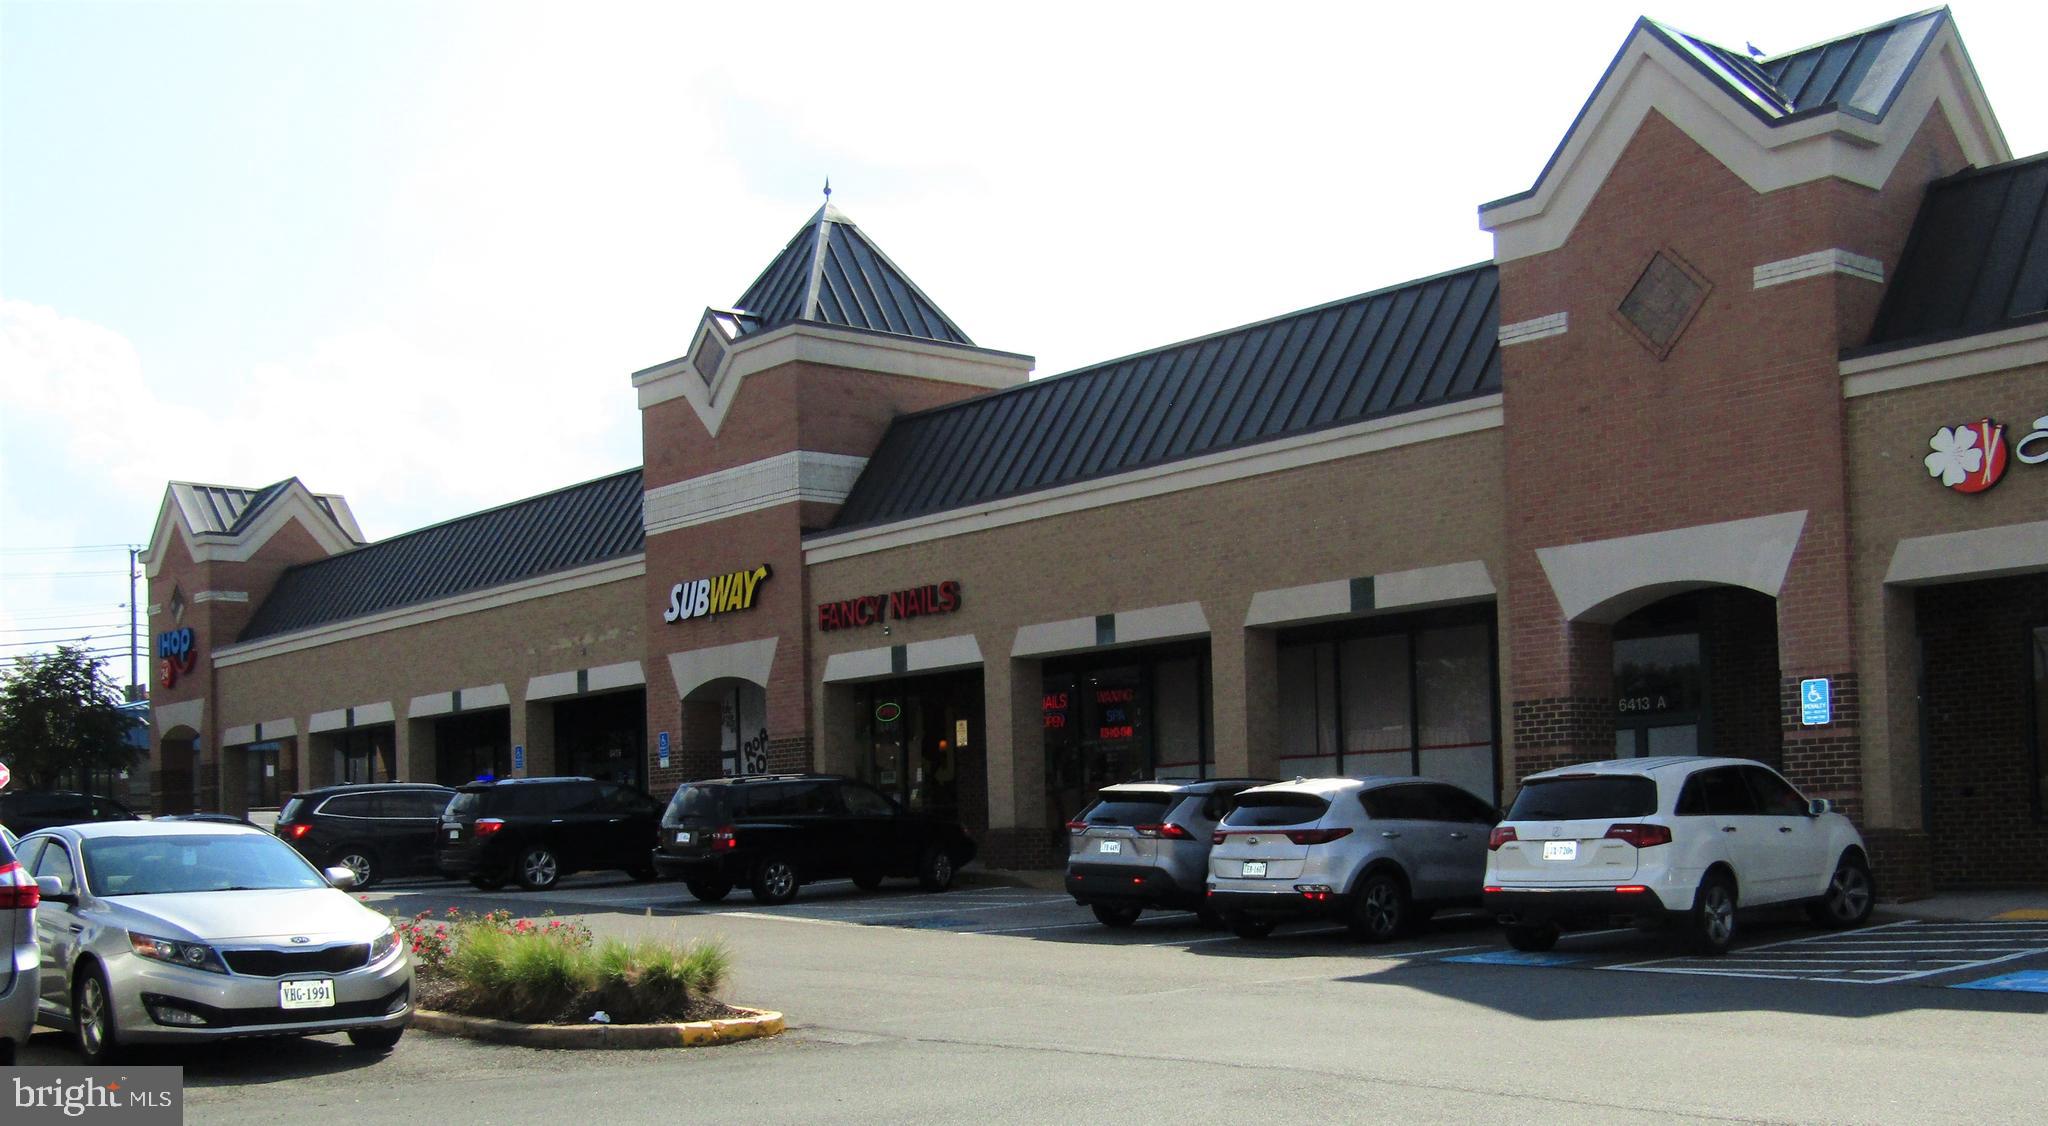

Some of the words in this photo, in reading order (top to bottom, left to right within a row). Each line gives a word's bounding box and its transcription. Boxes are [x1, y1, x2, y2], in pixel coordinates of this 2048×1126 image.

[664, 565, 769, 623] SUBWAY
[818, 595, 887, 631] FANCY
[890, 581, 960, 619] NAILS
[1618, 697, 1650, 712] 6413
[1657, 696, 1667, 709] A
[1105, 709, 1126, 722] SPA
[284, 986, 330, 1001] VHG-1991
